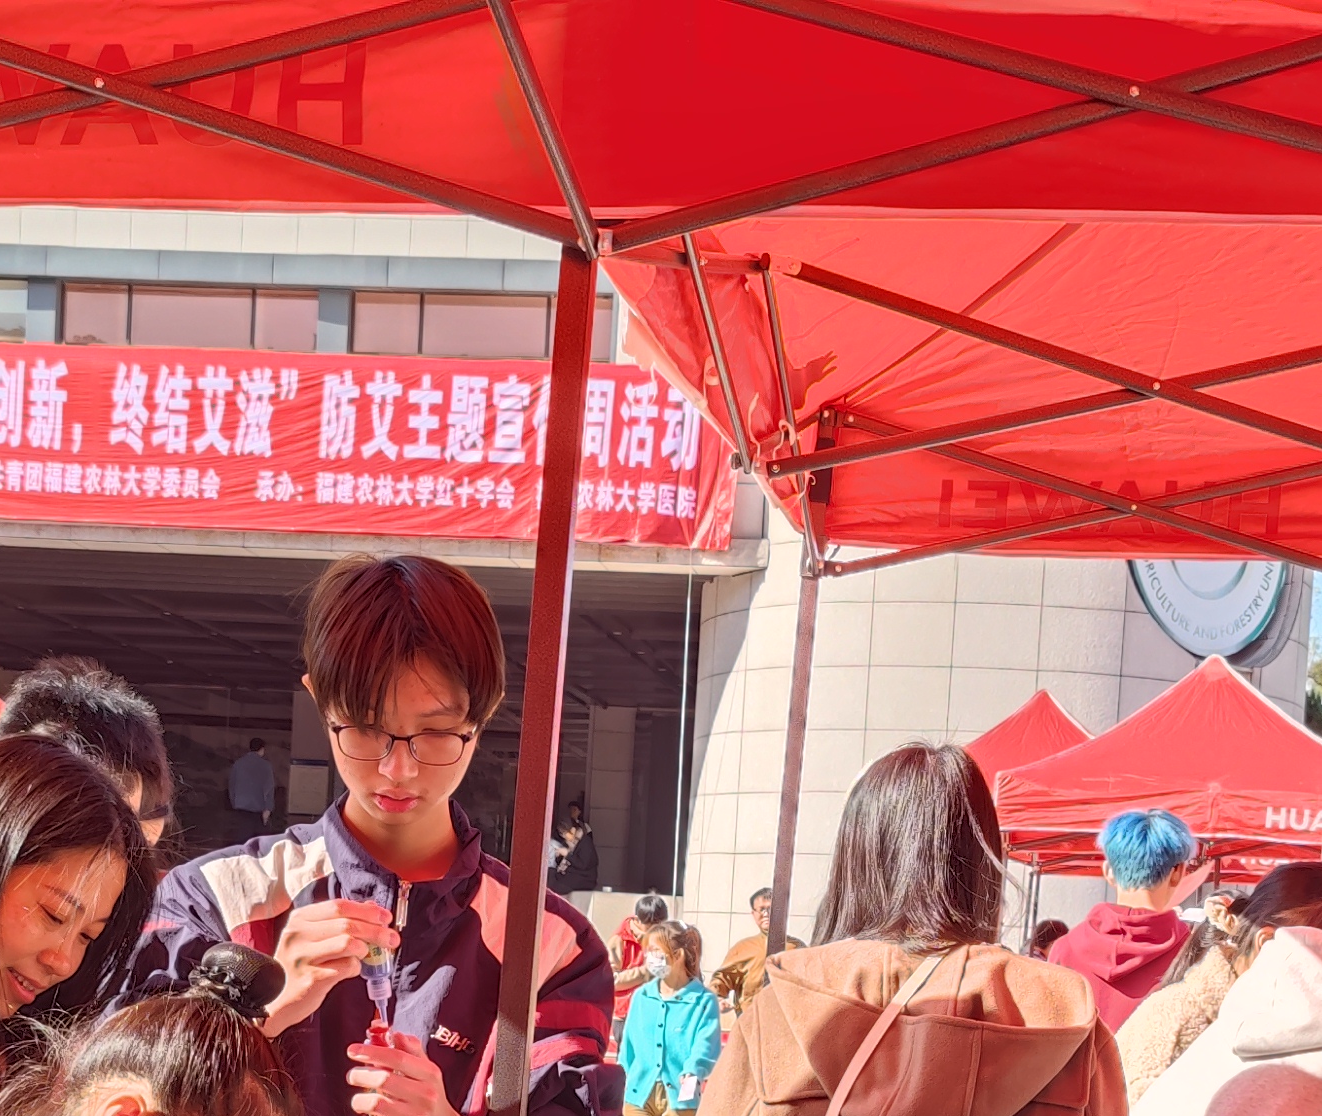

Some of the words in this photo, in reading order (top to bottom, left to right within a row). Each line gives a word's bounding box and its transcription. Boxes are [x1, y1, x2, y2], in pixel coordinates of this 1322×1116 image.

[536, 478, 697, 519] 农林大学医院
[1143, 558, 1190, 633] RICULTURE
[1193, 626, 1219, 641] AND
[1220, 591, 1265, 639] FORESTRY
